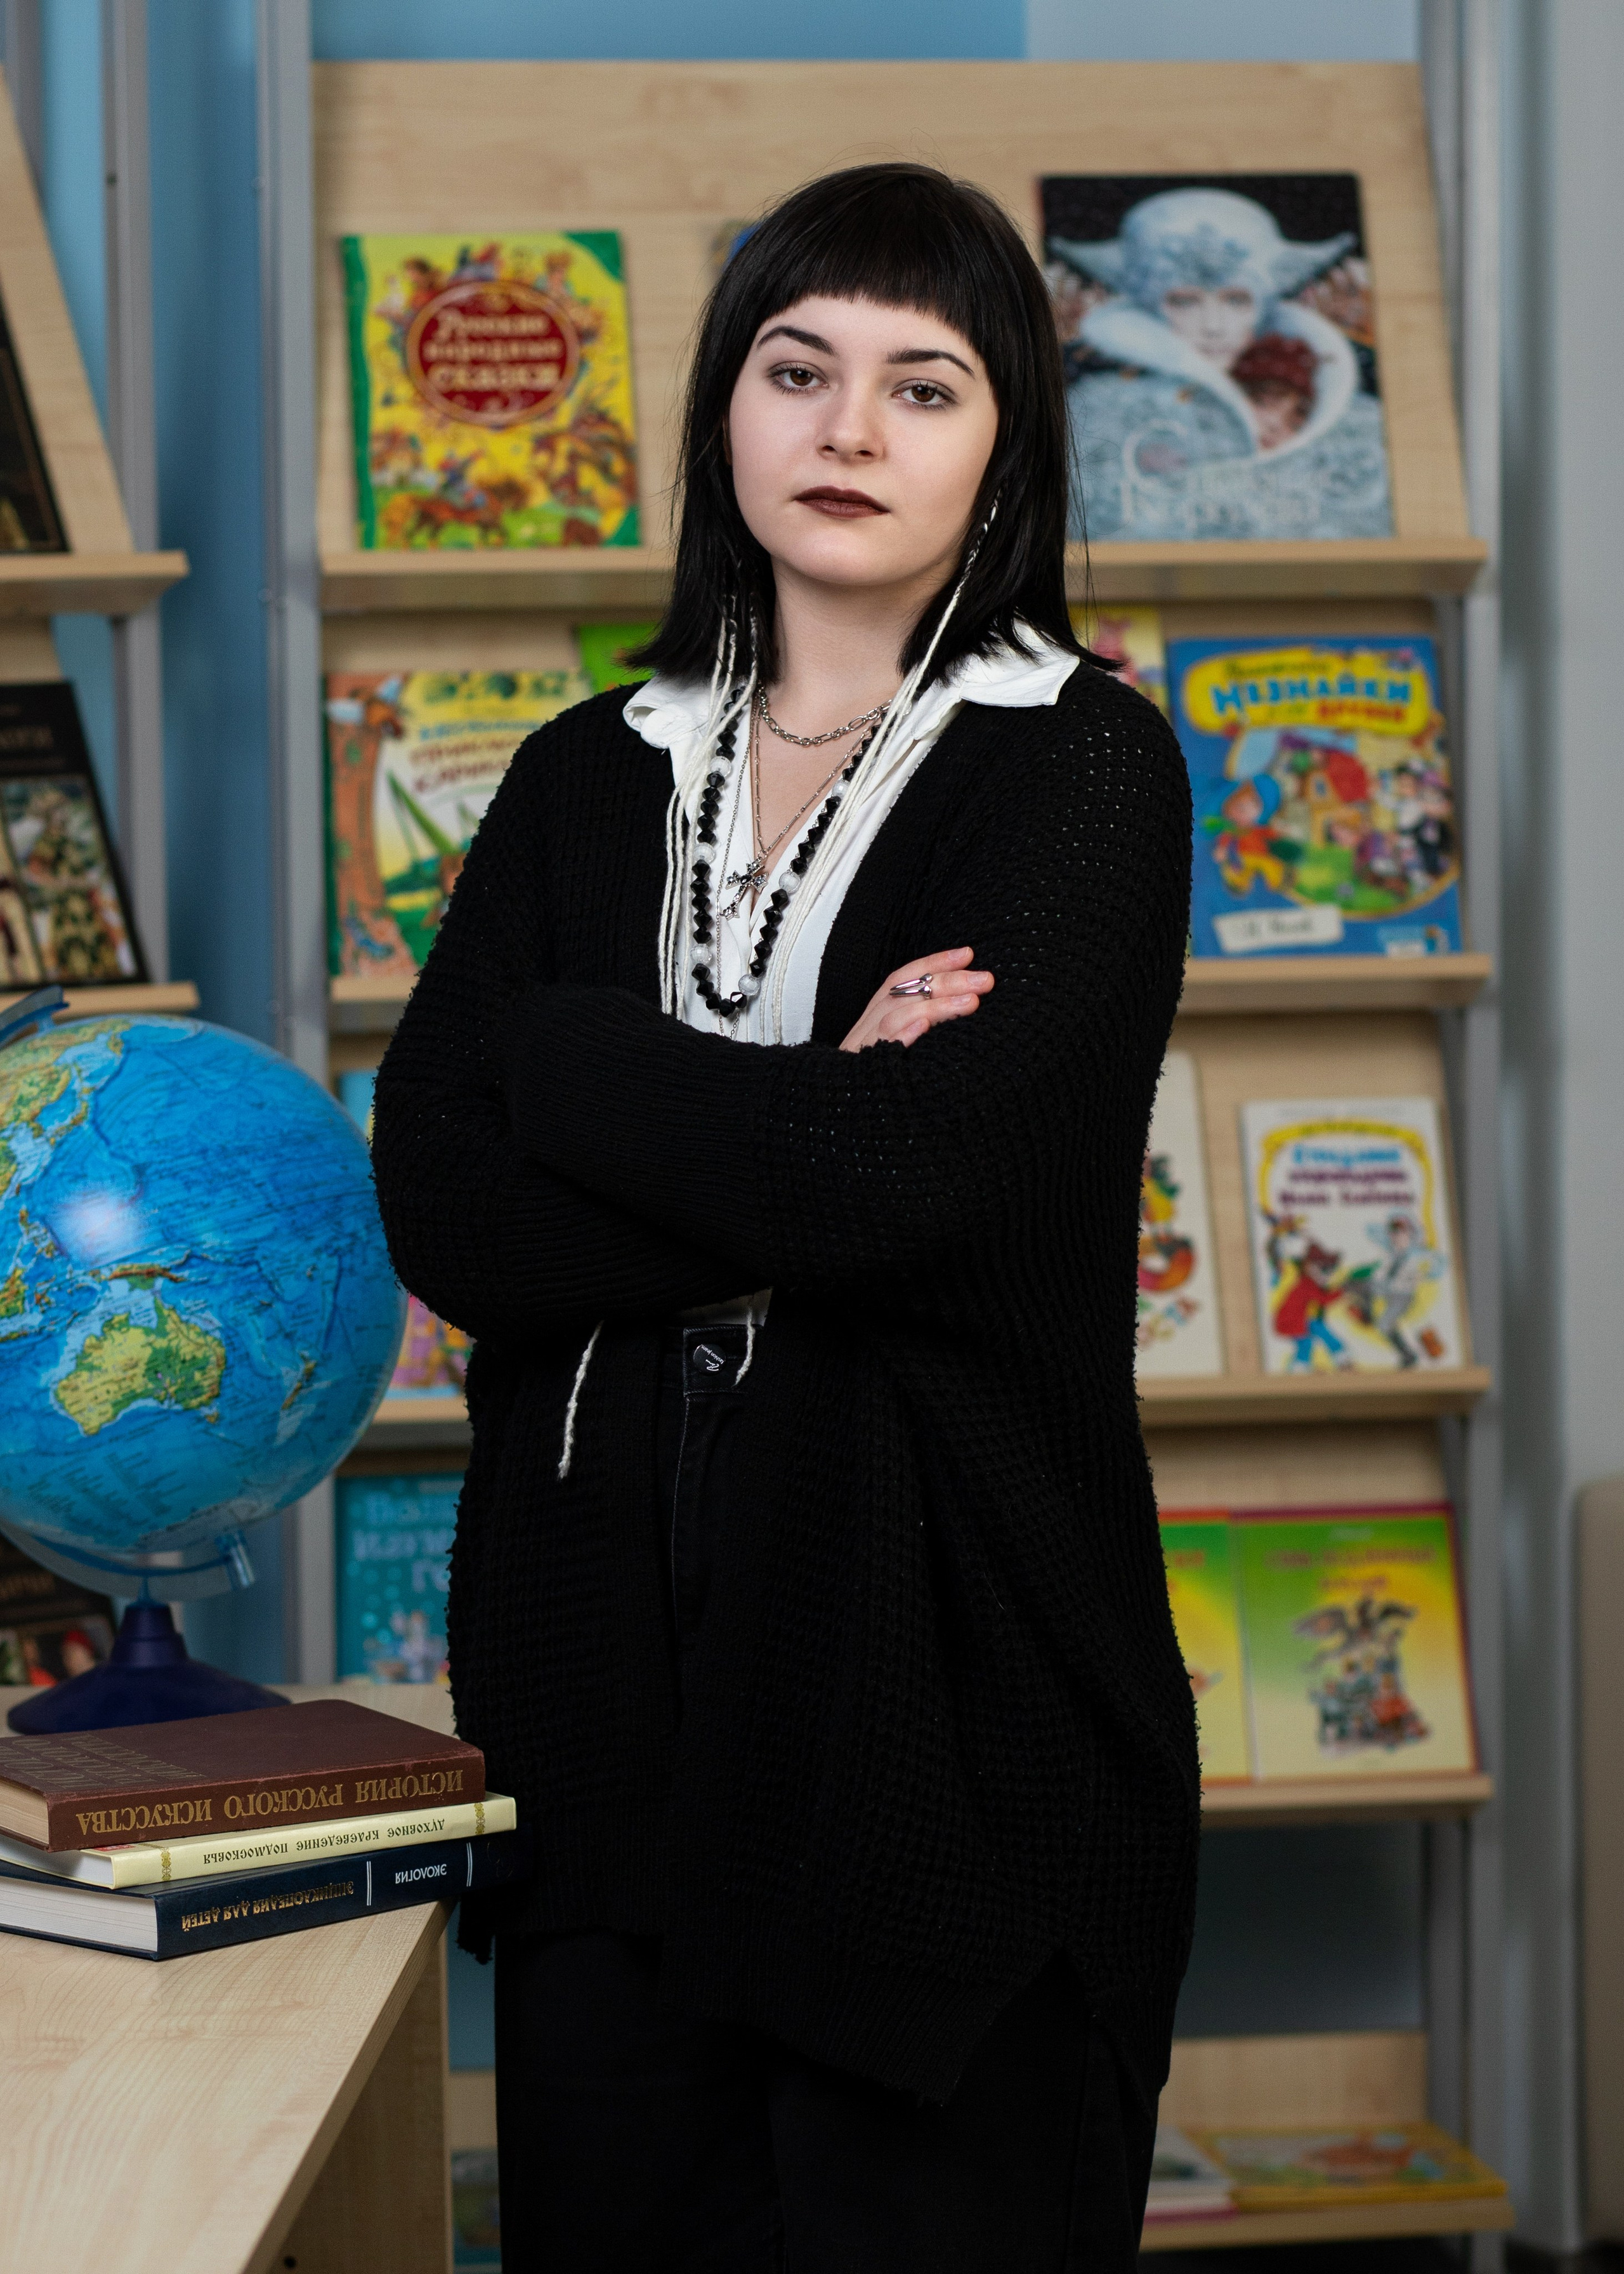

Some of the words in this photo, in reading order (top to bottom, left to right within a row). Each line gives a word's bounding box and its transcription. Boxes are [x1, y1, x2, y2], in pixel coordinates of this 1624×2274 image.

[355, 1770, 464, 1803] ИСТОРИЯ
[224, 1784, 344, 1819] РУССКОГО
[75, 1799, 213, 1836] ИСКУССТВА
[386, 1818, 445, 1838] ДУХОВНОЕ
[296, 1829, 379, 1851] КРАЕВЕДЕНИЕ
[202, 1843, 289, 1865] ПОДМОСКОВЬЯ
[395, 1863, 447, 1884] ЭКОЛОГИЯ
[252, 1881, 355, 1915] ЭНЦИКЛОПЕДИЯ
[181, 1907, 221, 1932] ДЕТЕЙ
[223, 1900, 251, 1921] ДЛЯ
